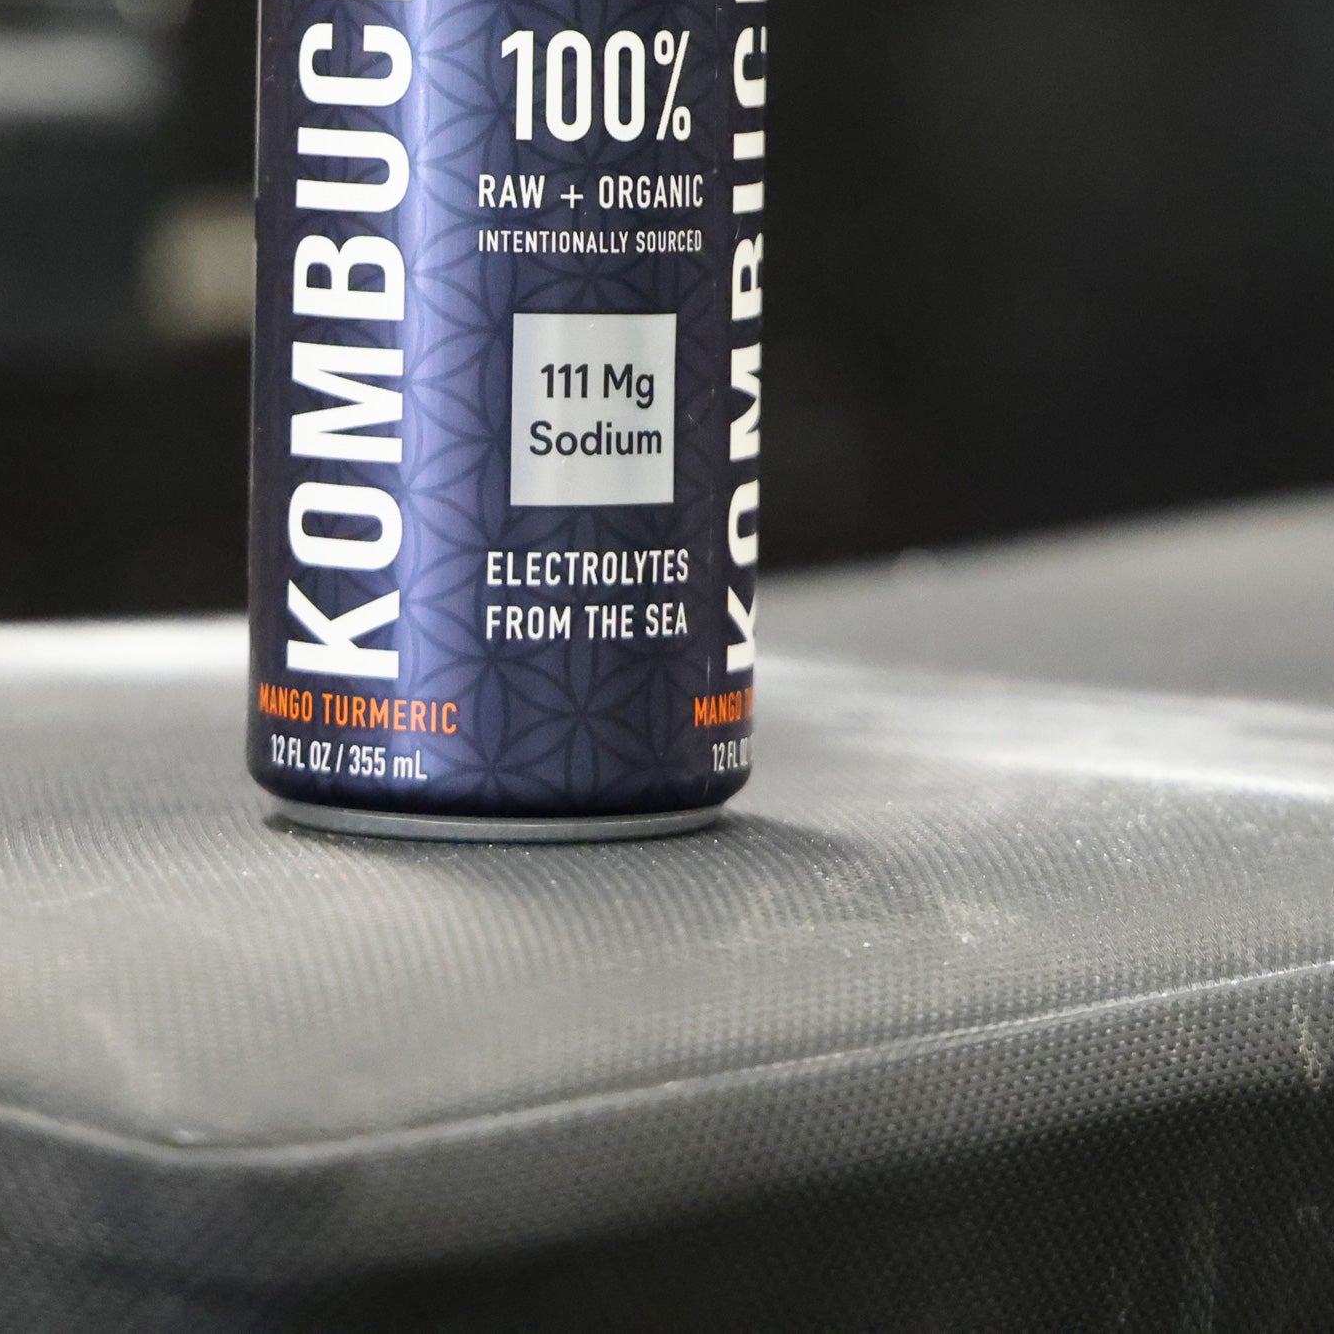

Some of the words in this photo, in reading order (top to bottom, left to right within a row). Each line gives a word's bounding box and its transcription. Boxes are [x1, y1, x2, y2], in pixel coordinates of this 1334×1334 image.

[501, 29, 692, 142] 100%
[478, 174, 546, 209] RAW
[560, 184, 584, 209] +
[598, 174, 704, 210] ORGANIC
[478, 229, 629, 254] INTENTIONALLY
[635, 229, 703, 254] SOURCED
[540, 363, 589, 399] 111
[603, 363, 655, 409] Mg
[529, 420, 662, 456] Sodium
[486, 548, 689, 587] ELECTROLYTES
[485, 605, 571, 640] FROM
[584, 604, 635, 640] THE
[645, 601, 689, 638] SEA
[259, 681, 313, 723] MANGO
[321, 692, 459, 735] TURMERIC
[694, 690, 743, 727] MANGO
[270, 733, 285, 765] 12
[288, 736, 306, 770] FL
[310, 740, 332, 773] OZ
[349, 744, 387, 777] 355
[393, 749, 428, 781] mL
[712, 743, 725, 772] 12
[727, 740, 739, 770] FL
